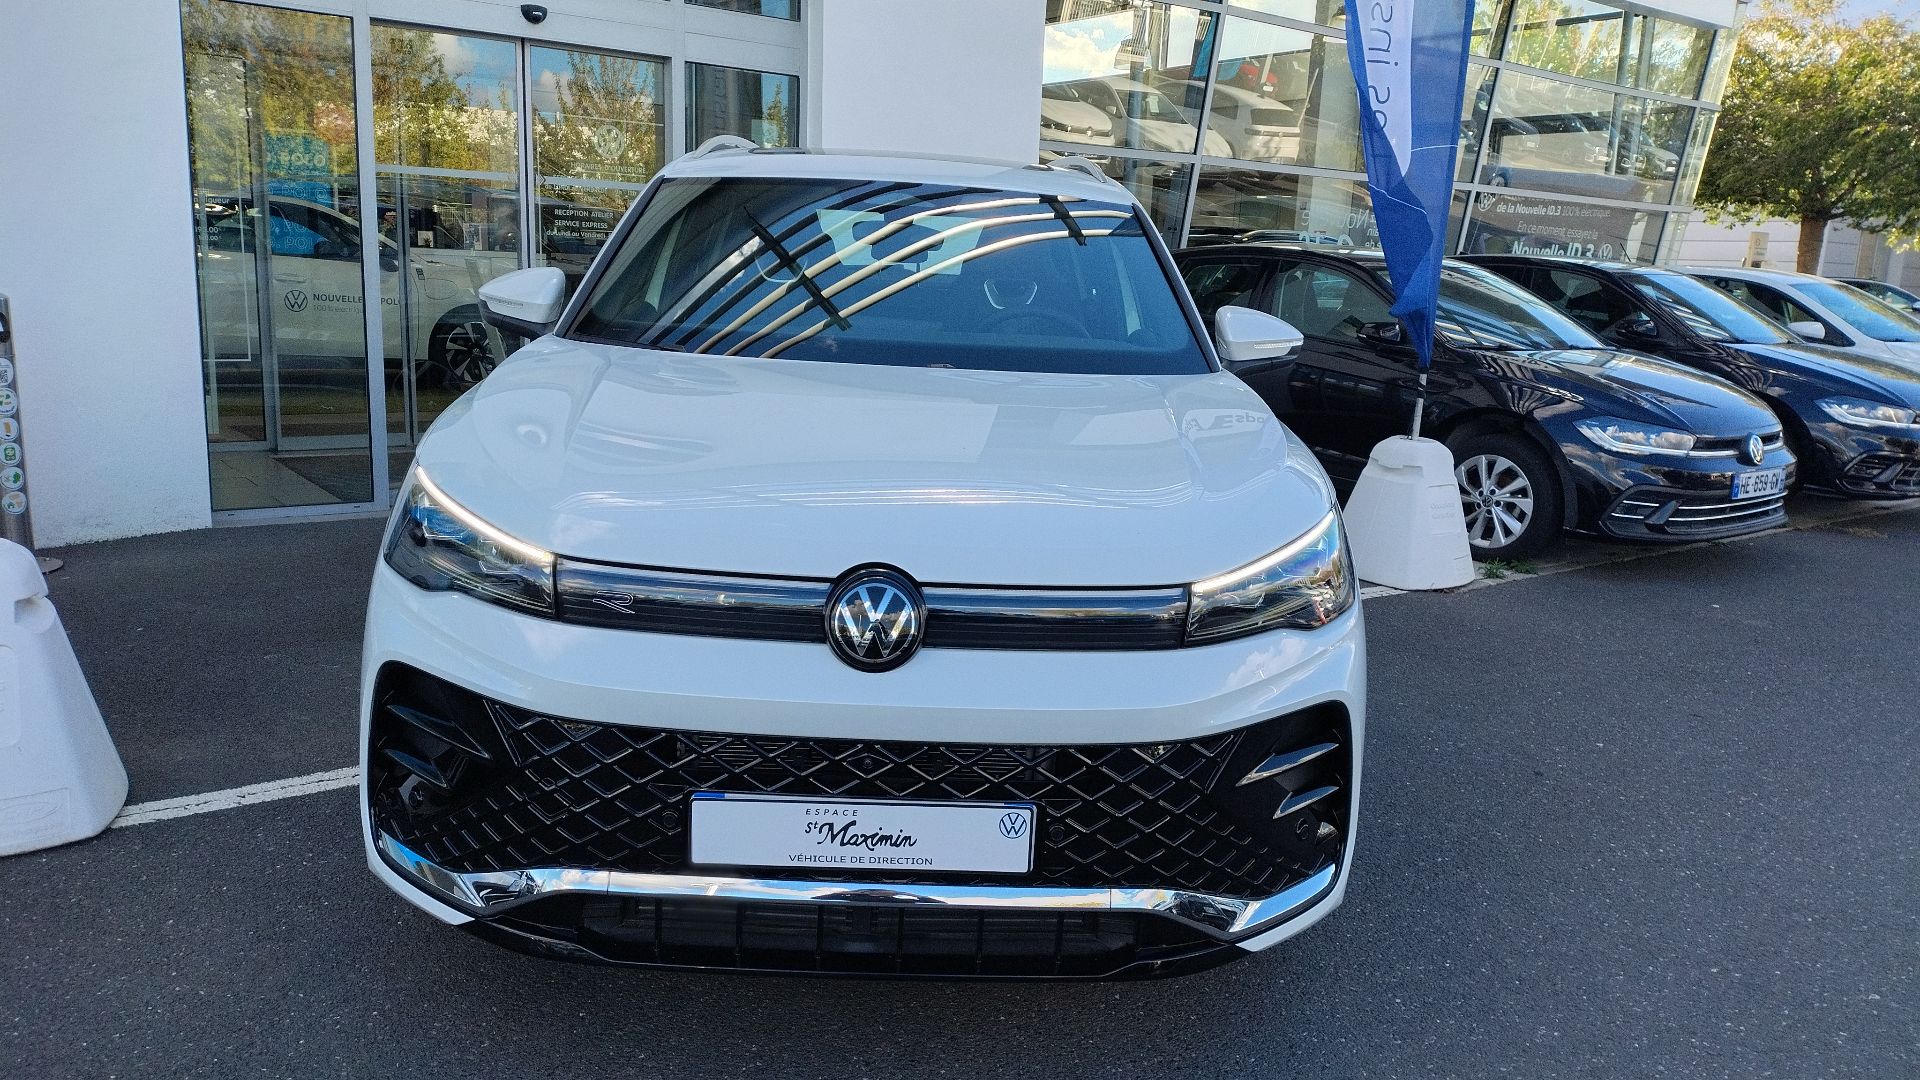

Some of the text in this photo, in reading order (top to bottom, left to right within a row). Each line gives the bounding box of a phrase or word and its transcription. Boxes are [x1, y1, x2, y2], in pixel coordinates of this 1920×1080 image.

[554, 208, 614, 219] RECEPTION ATELIER
[1496, 202, 1507, 213] de
[1507, 203, 1515, 213] la
[1514, 203, 1547, 216] Nouvelle
[1547, 205, 1561, 216] ID.3
[554, 219, 609, 229] SERVICE EXPRESS
[313, 293, 363, 304] NOUVELLE
[805, 808, 859, 817] ESPACE
[804, 820, 918, 851] St Maximin
[788, 852, 933, 866] VÉHICULE DE DIRECTION
